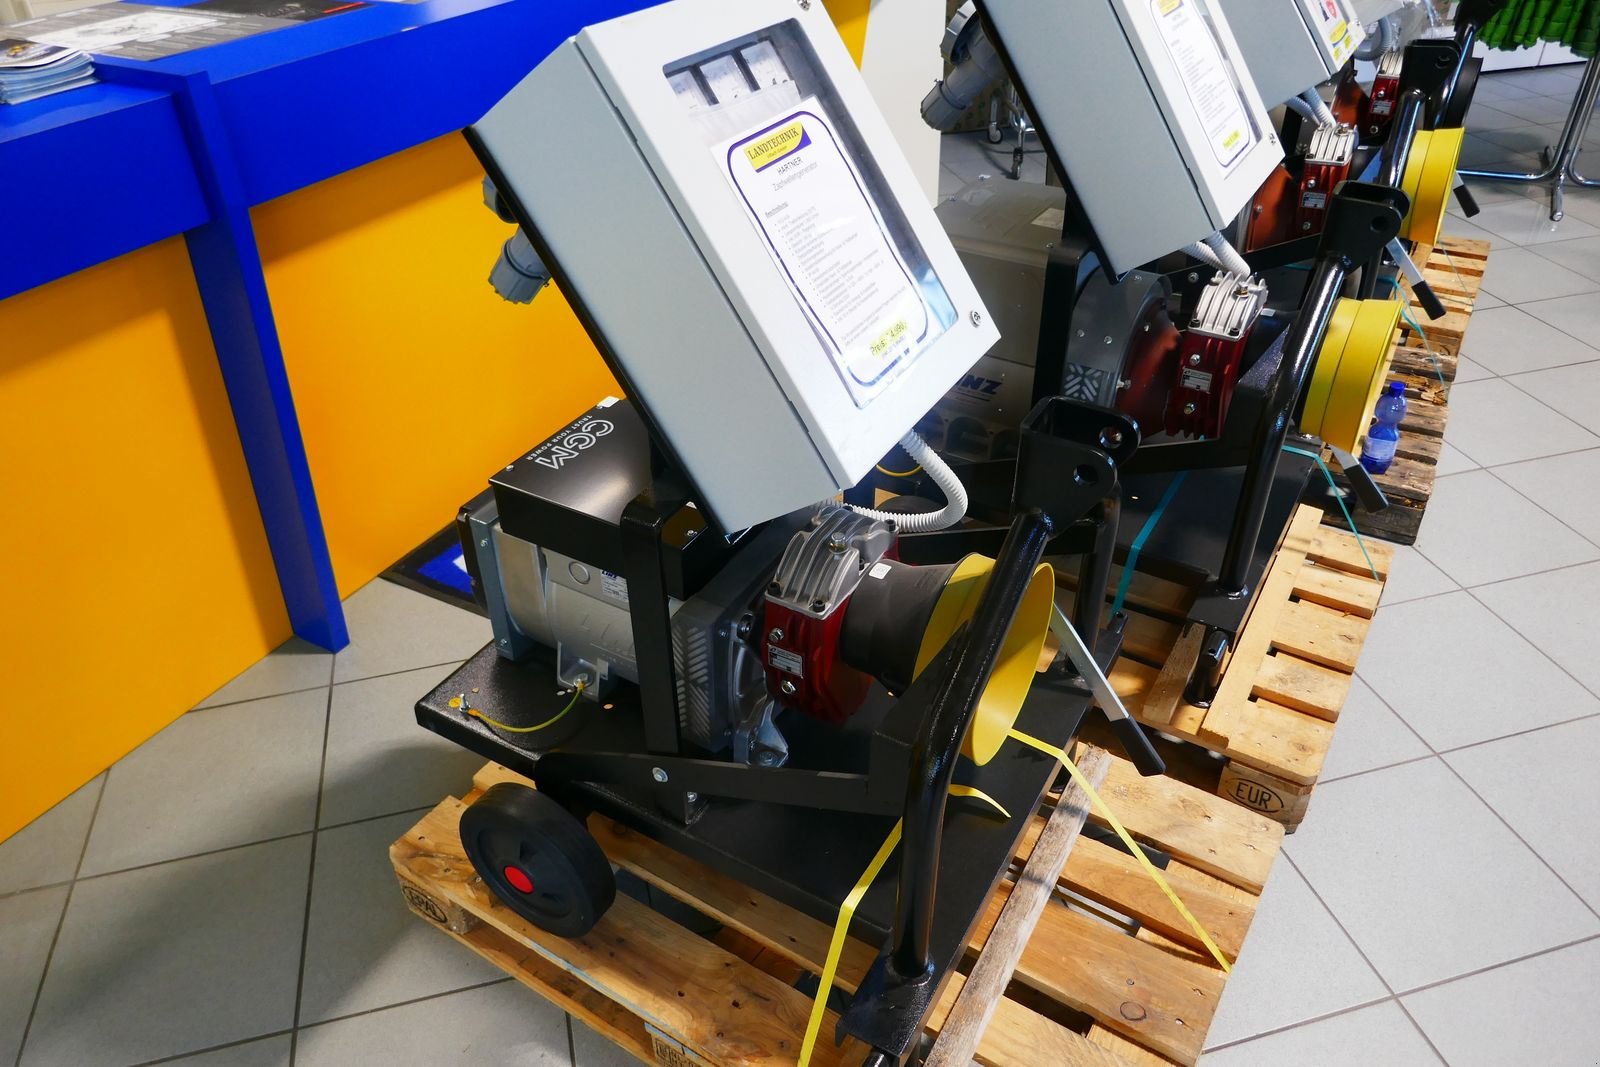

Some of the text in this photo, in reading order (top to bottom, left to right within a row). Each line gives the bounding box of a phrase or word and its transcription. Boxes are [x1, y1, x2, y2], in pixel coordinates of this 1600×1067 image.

[747, 127, 800, 160] LANDTECHNIK
[960, 374, 1003, 395] NZ
[526, 414, 593, 461] TRUST YOUR POWER
[535, 419, 615, 470] CGM
[1235, 781, 1272, 809] EUR
